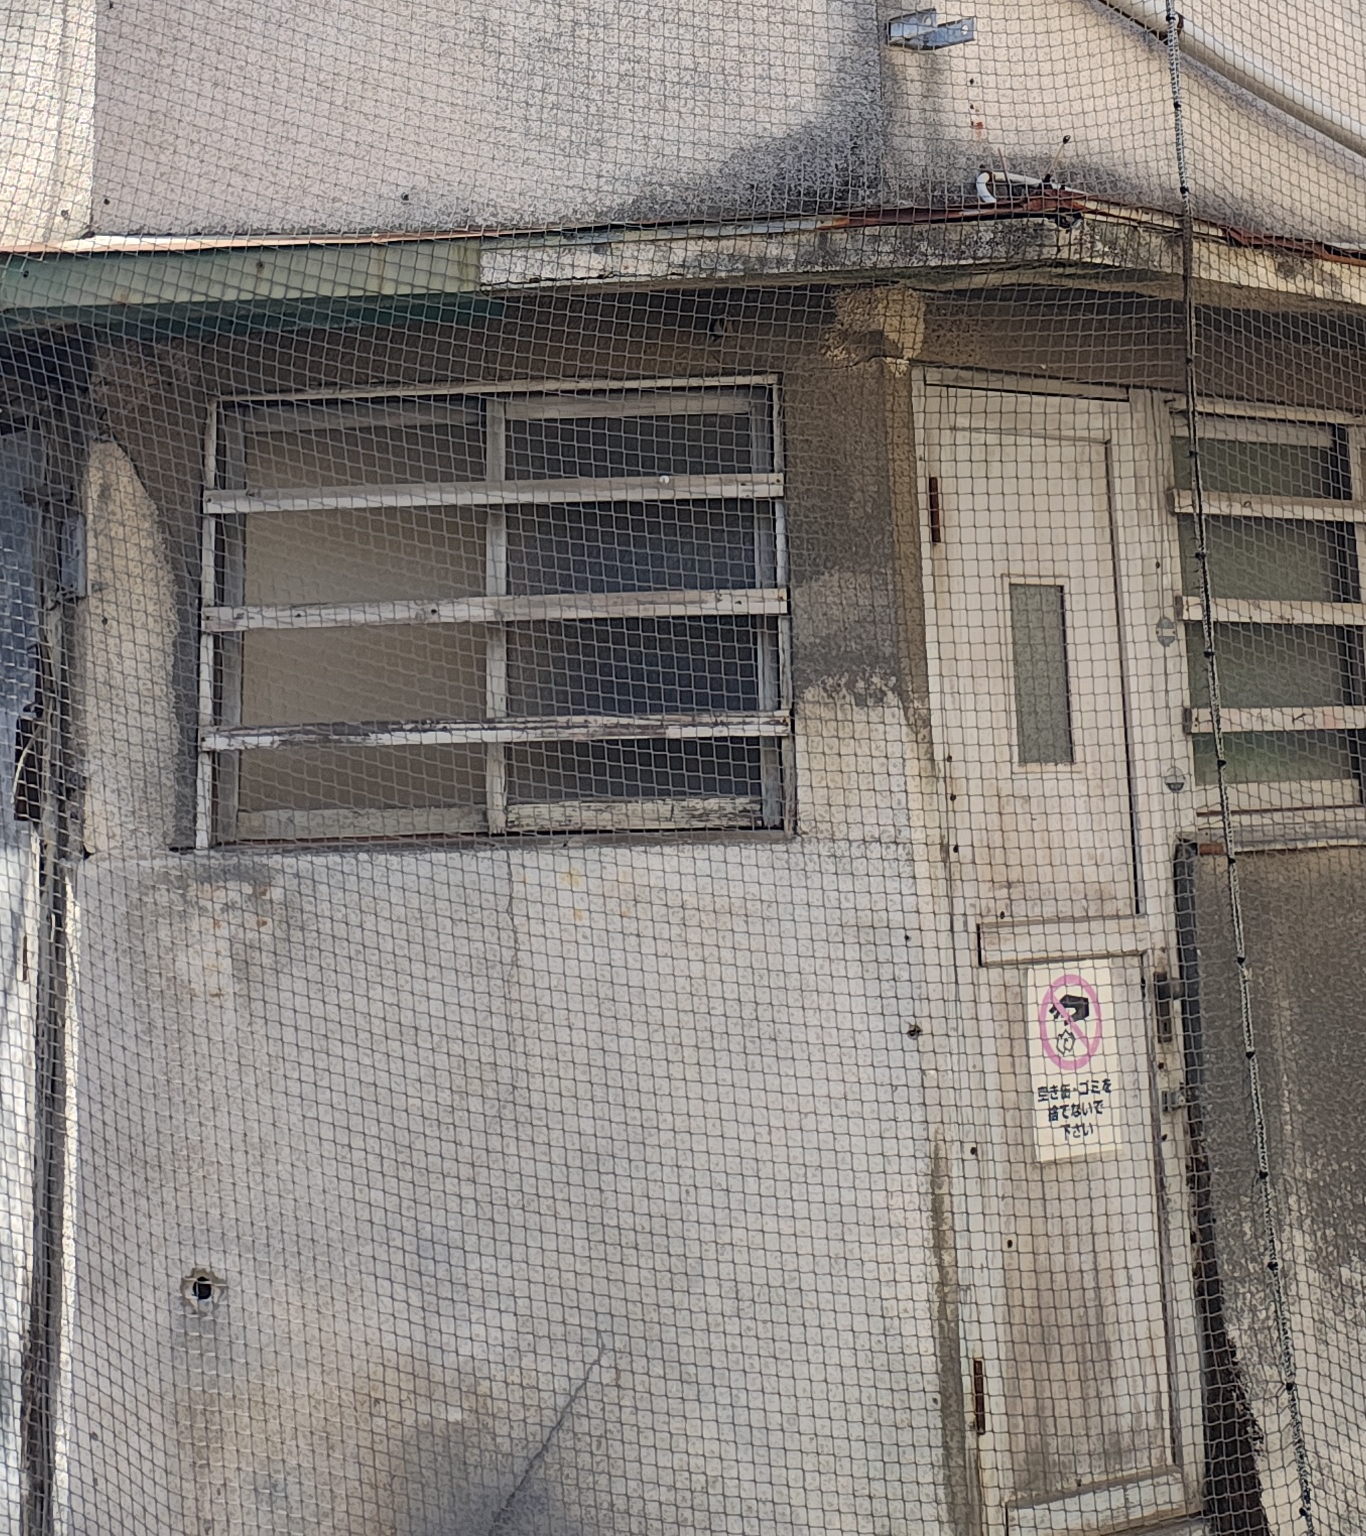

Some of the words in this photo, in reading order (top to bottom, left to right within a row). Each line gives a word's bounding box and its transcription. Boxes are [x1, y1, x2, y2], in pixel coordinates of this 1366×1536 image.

[1038, 1078, 1112, 1102] 空き缶・ゴミを
[1048, 1100, 1104, 1122] 捨てないで
[1060, 1122, 1094, 1141] 下さい
